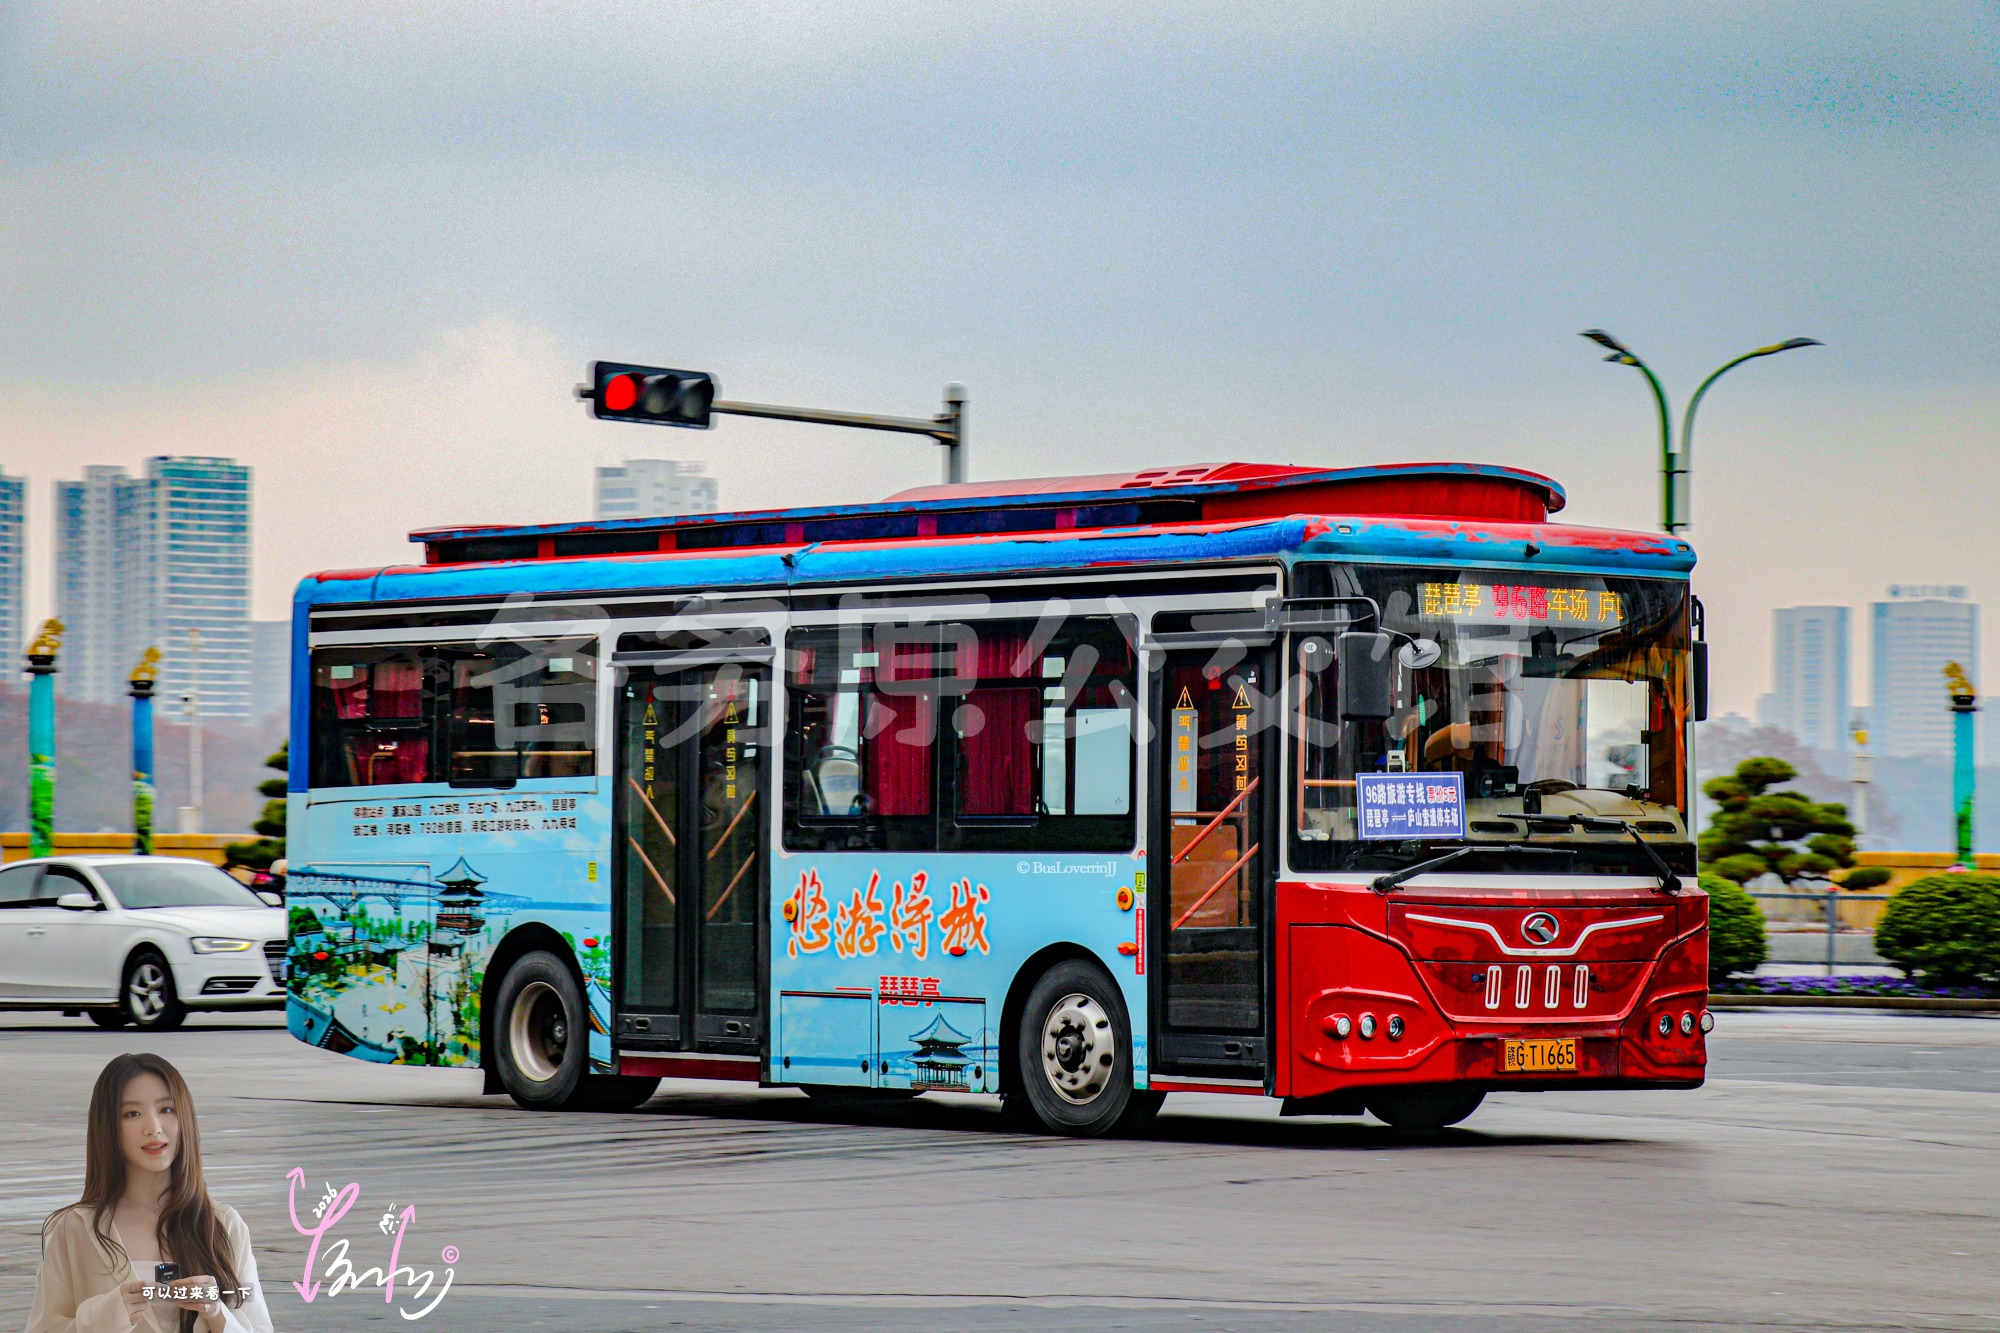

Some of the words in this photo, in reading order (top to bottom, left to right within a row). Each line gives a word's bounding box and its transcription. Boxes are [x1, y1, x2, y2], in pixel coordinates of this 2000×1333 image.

[1425, 582, 1482, 616] 琵琶亭
[1491, 583, 1549, 620] 96路
[1365, 782, 1426, 806] 96路旅游专线
[1365, 808, 1390, 828] 琵琶亭
[1407, 807, 1459, 828] 庐山索道停车场
[879, 975, 941, 1007] 琵琶亭
